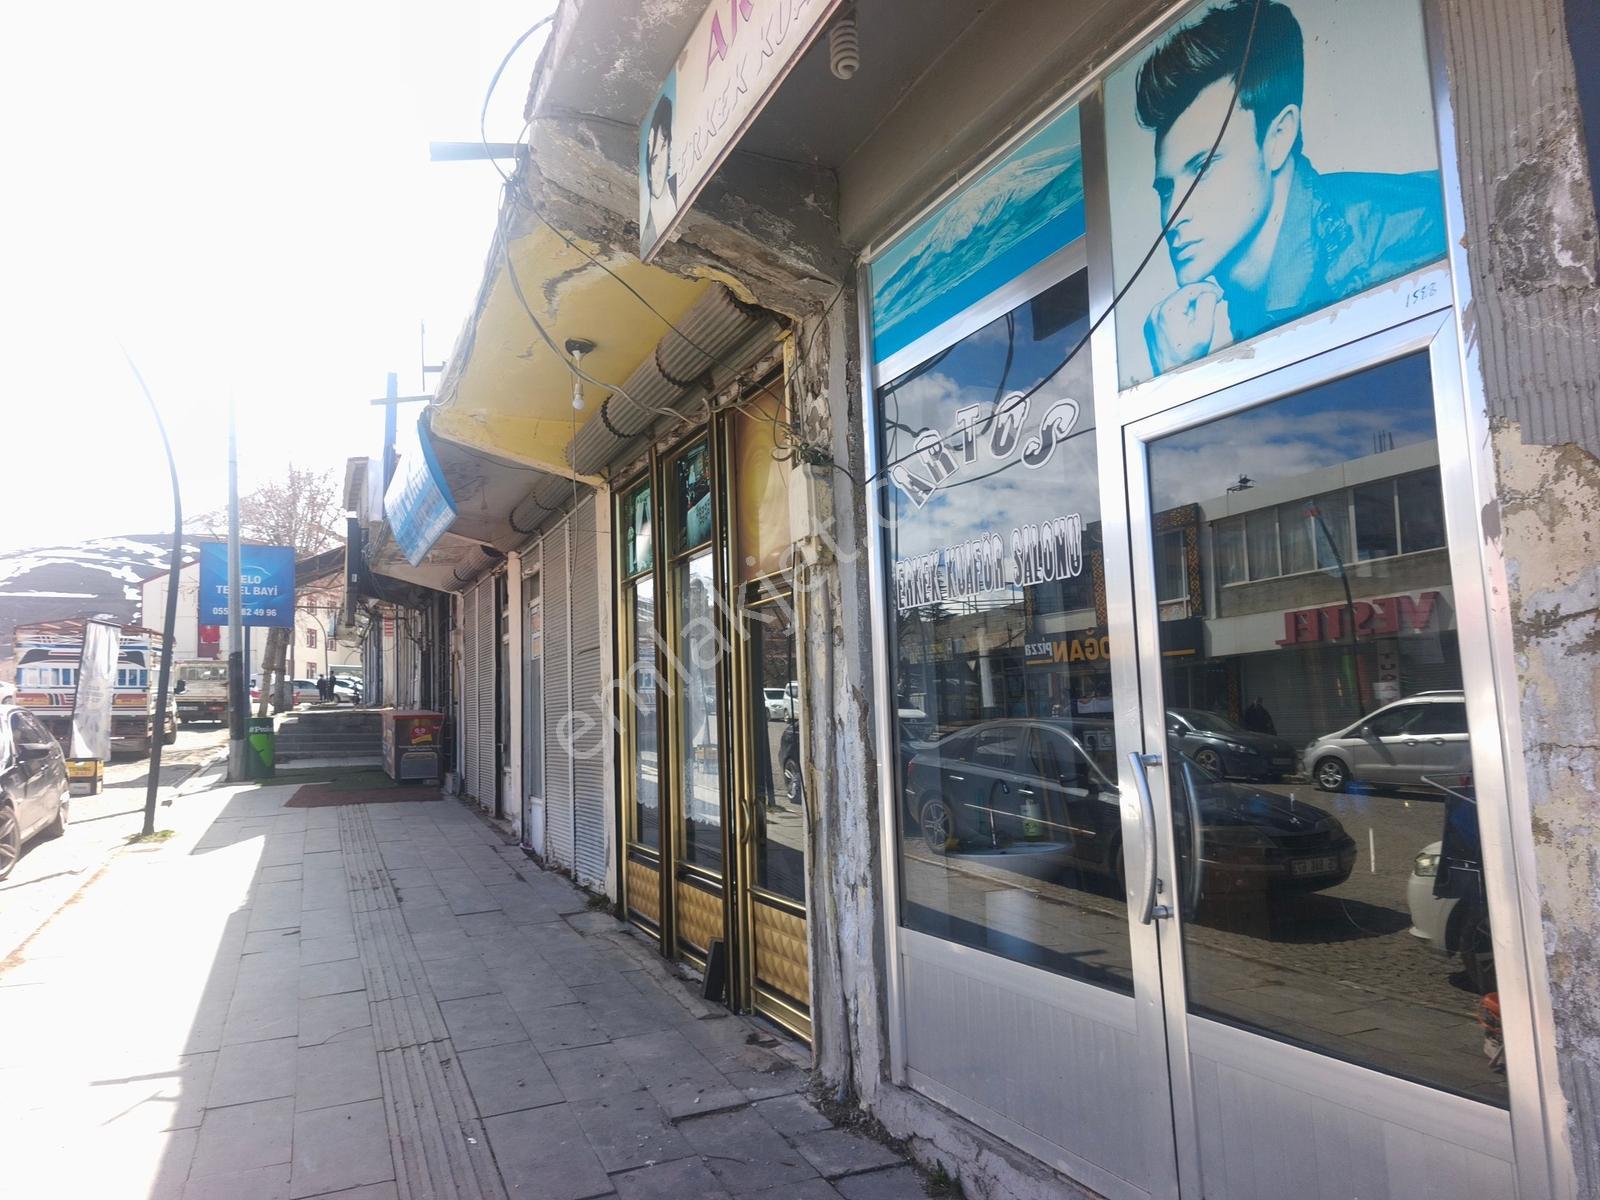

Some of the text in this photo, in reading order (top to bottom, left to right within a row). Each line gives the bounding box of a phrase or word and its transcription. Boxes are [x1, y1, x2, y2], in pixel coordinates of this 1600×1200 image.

[890, 391, 1080, 510] ARTOS
[896, 551, 942, 610] ERKEK
[1010, 512, 1082, 588] SALONU
[240, 575, 261, 584] ELO
[216, 585, 278, 596] TEEL BAYİ
[212, 607, 229, 615] 055
